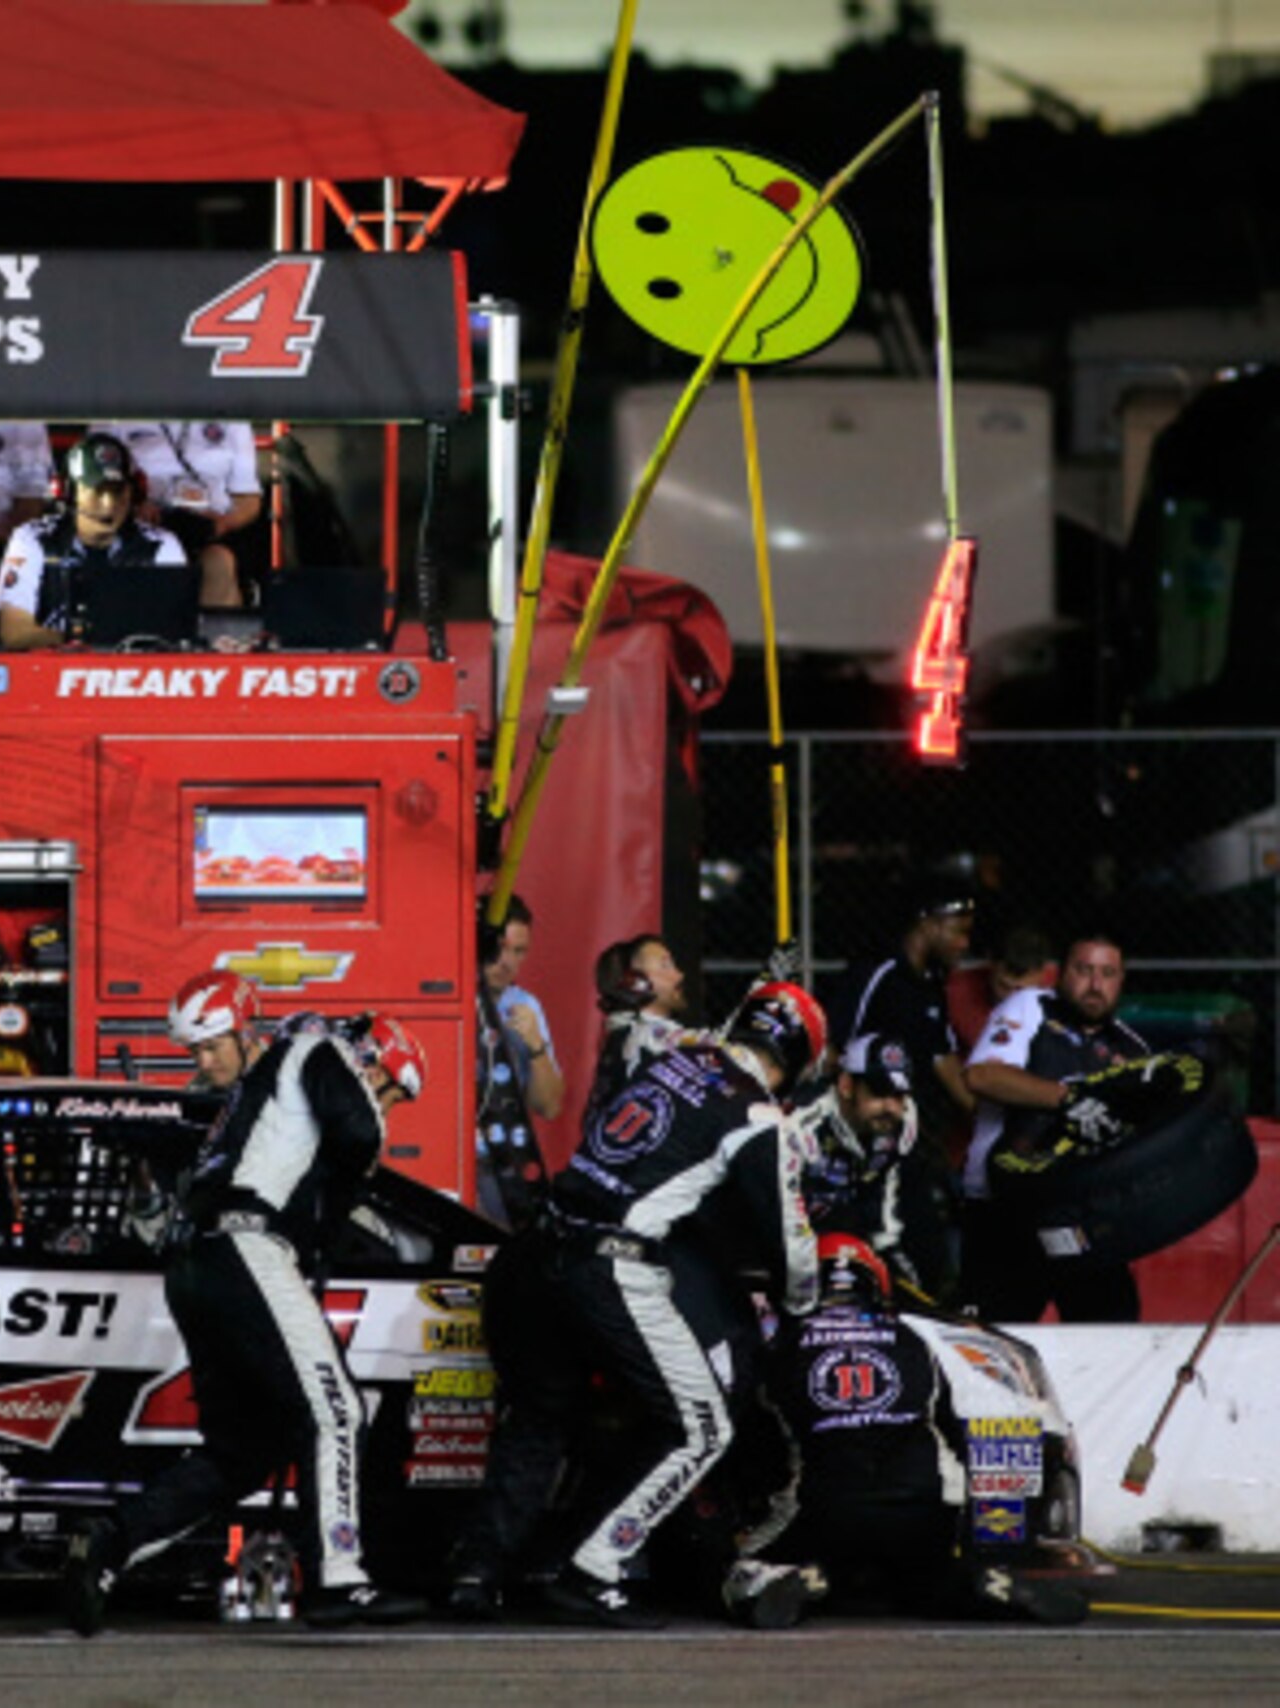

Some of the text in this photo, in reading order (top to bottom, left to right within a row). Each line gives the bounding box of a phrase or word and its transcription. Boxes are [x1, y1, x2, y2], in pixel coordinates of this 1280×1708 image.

[181, 256, 325, 378] 4
[56, 668, 360, 697] FREAKY FAST!
[911, 537, 976, 769] 4
